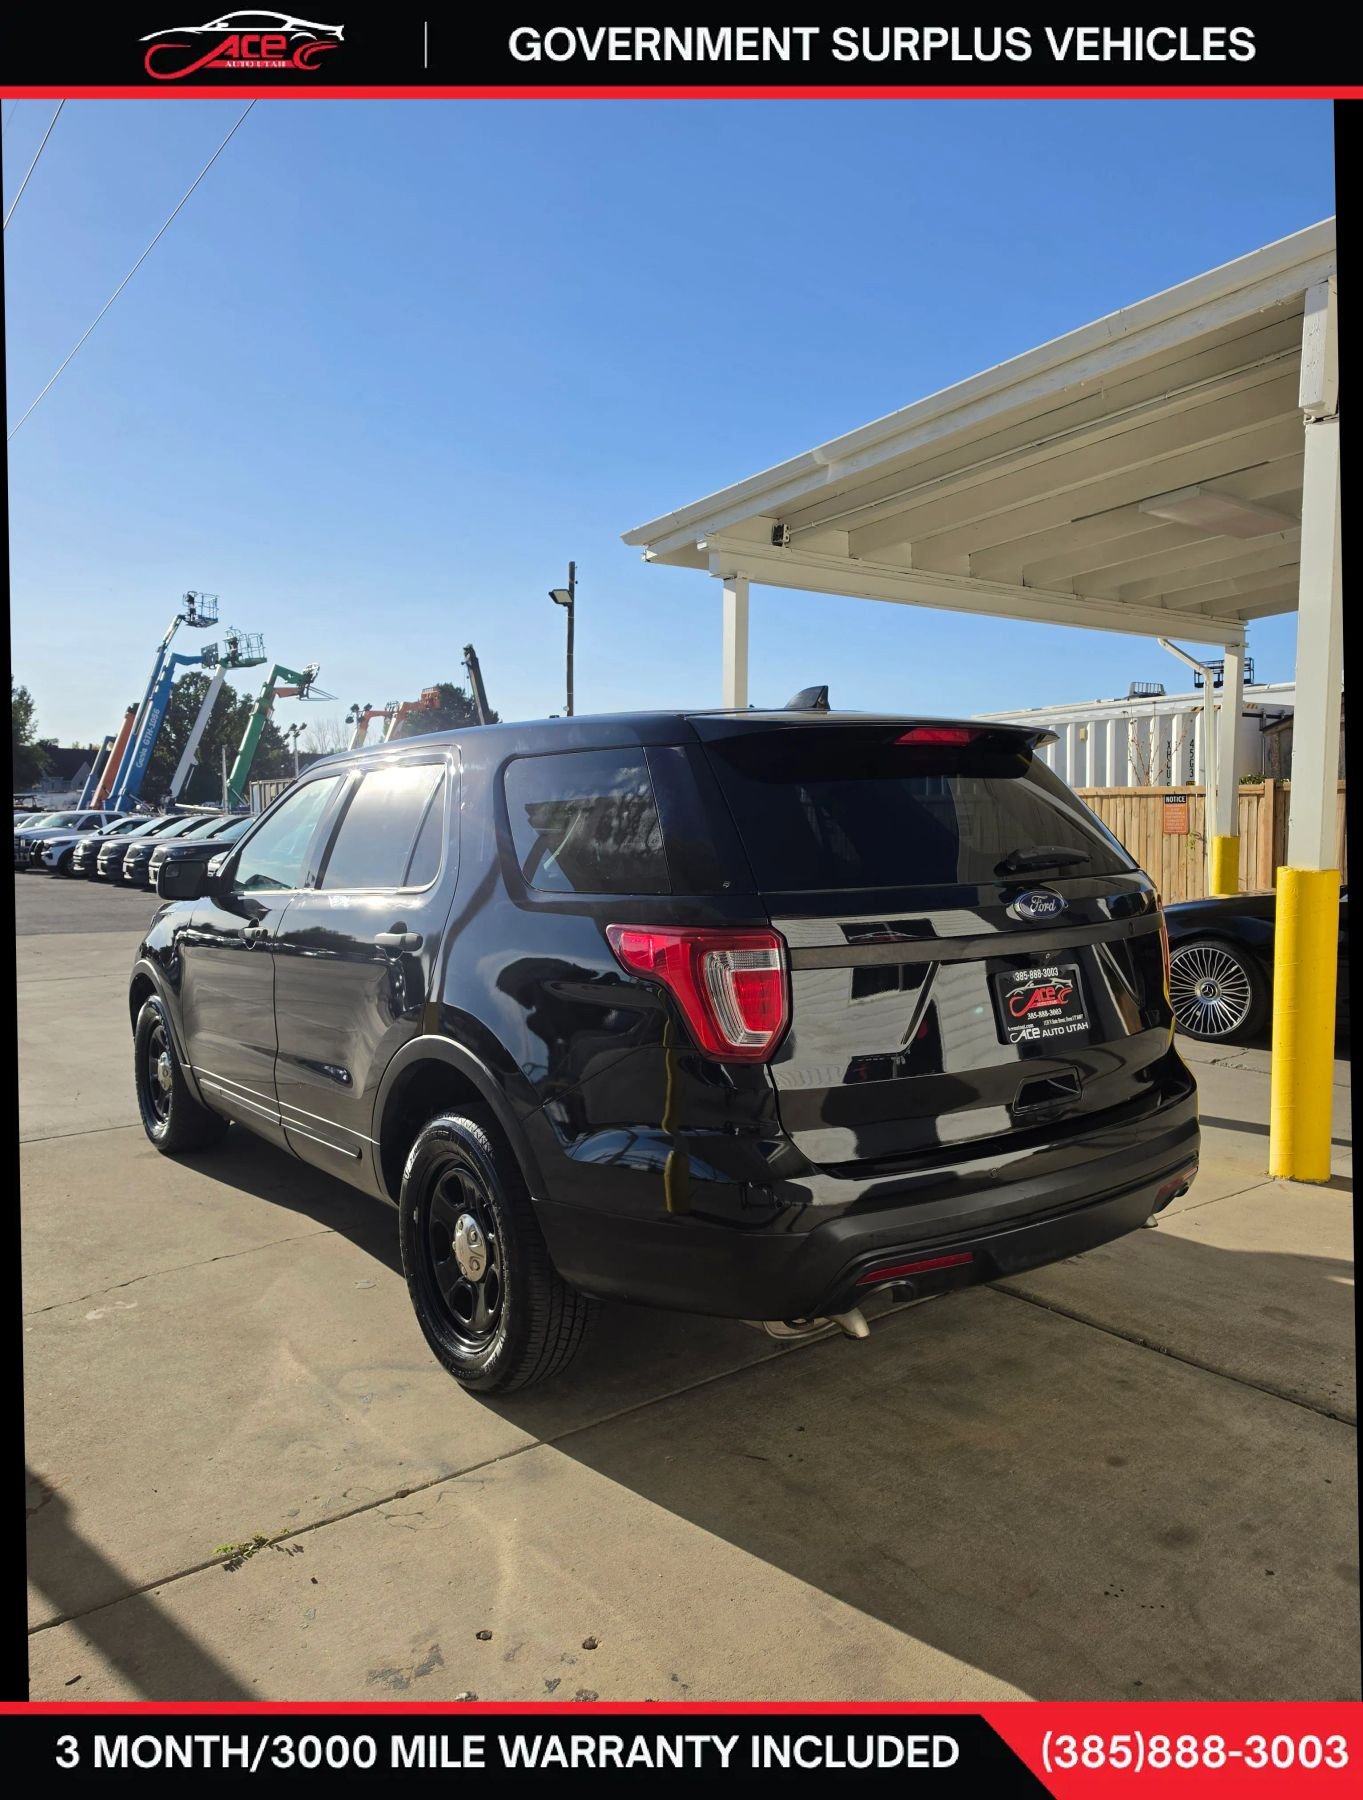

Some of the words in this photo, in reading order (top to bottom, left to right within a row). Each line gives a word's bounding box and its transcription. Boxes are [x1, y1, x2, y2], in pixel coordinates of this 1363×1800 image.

[1165, 795, 1186, 803] NOTICE
[1030, 895, 1057, 913] Ford
[1014, 967, 1059, 982] 385-888-3003
[1042, 1027, 1065, 1037] AUTO
[1066, 1022, 1089, 1033] UTAH
